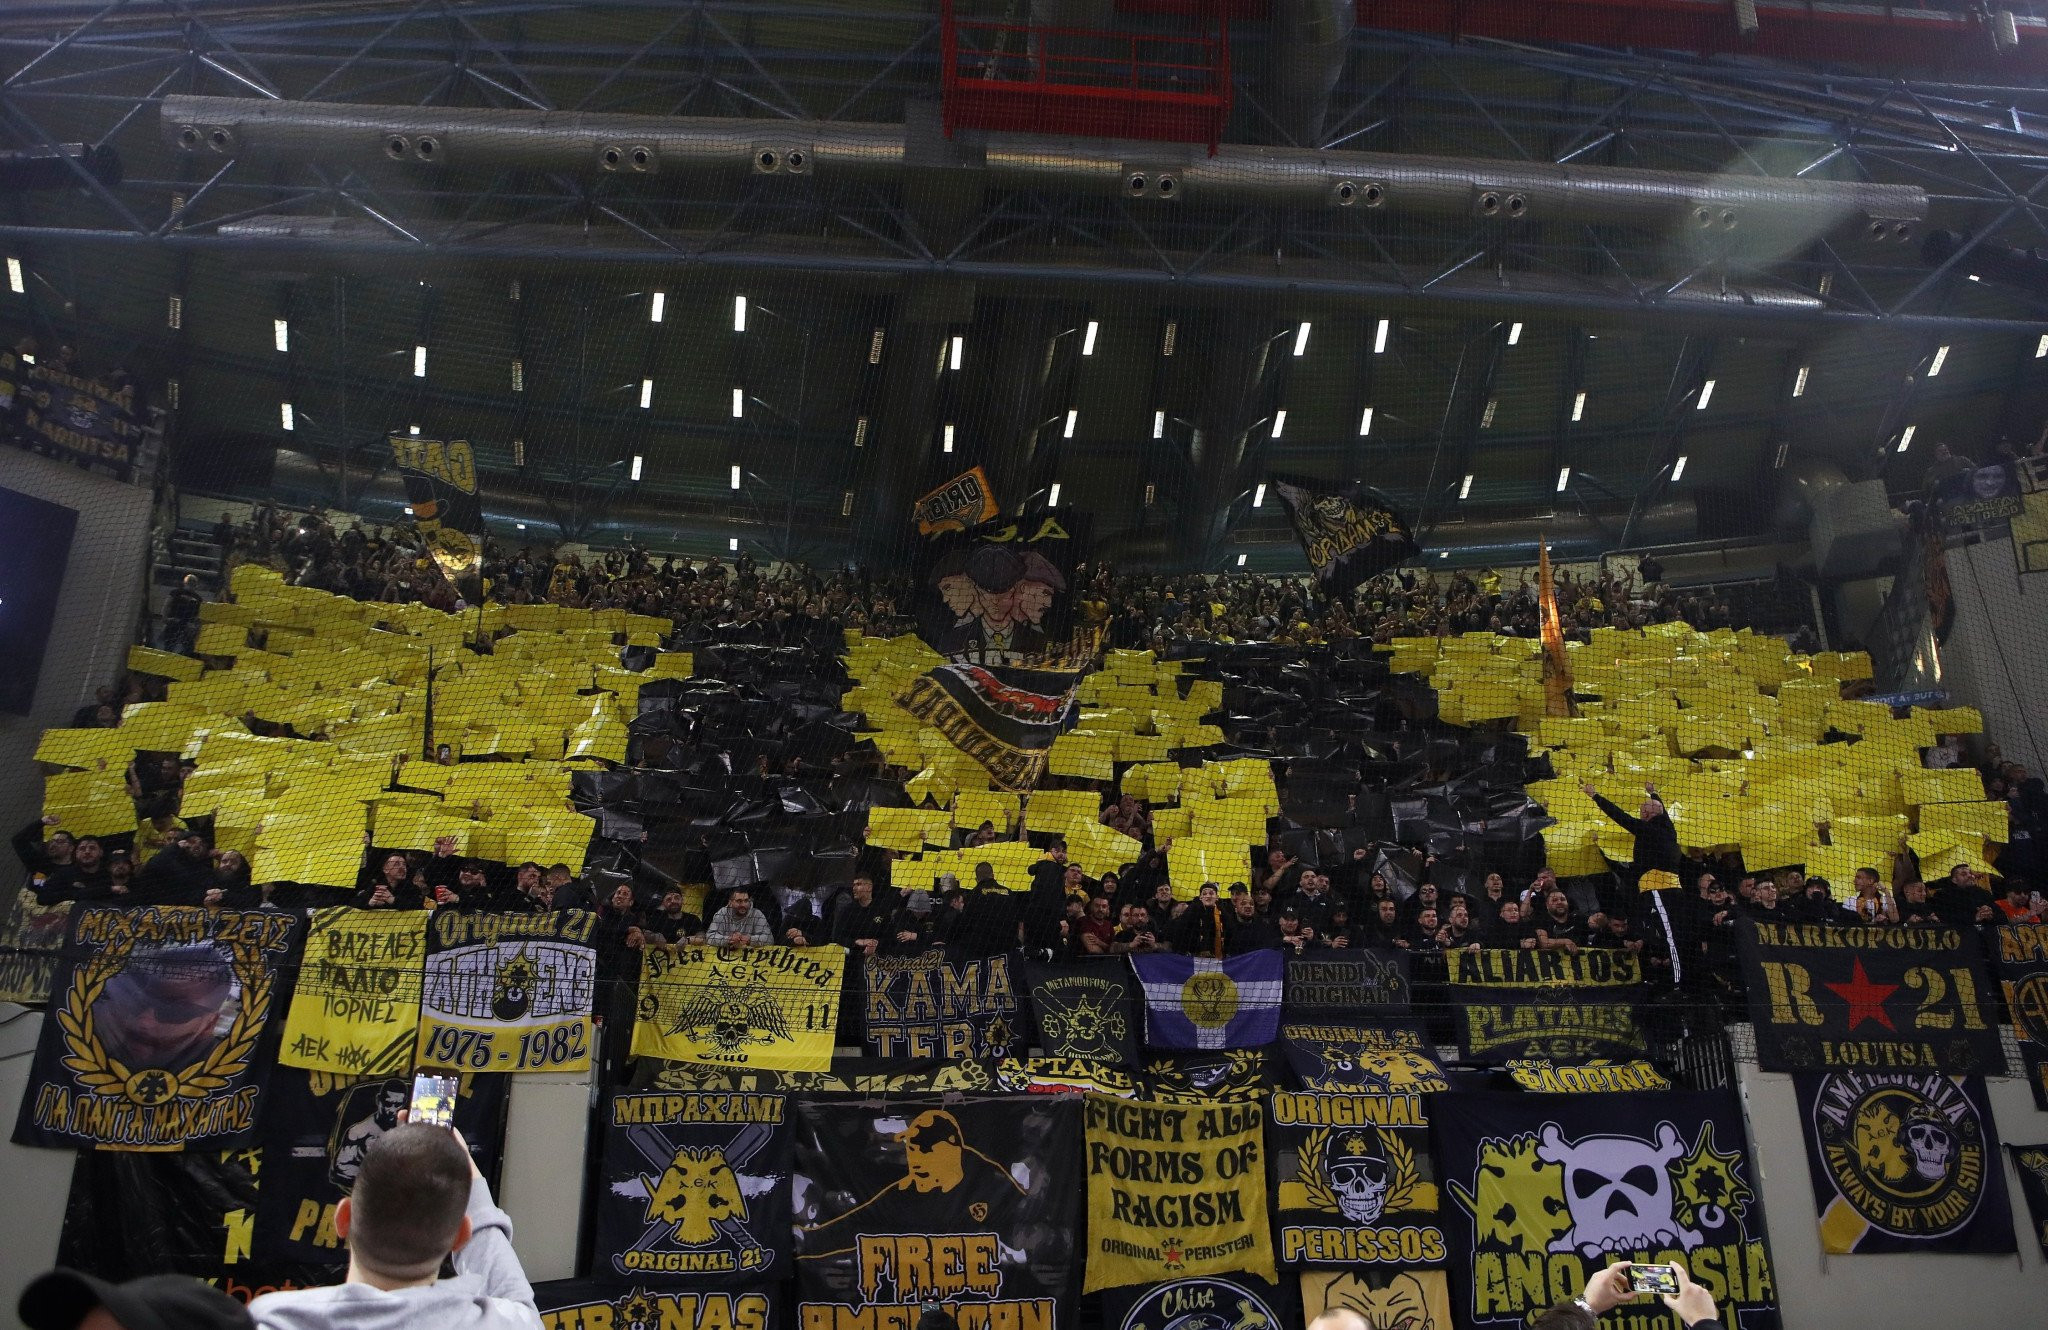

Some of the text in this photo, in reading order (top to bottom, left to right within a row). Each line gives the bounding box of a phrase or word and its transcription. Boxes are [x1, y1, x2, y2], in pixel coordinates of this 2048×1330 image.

[435, 908, 599, 947] Original 21
[1755, 922, 1961, 951] MARKOPOULO
[1288, 961, 1365, 984] MENIDI
[1458, 948, 1634, 983] ALIARTOS
[865, 954, 1017, 1022] KAMA
[1289, 984, 1389, 1007] ORIGINAL
[1761, 962, 1824, 1026] R
[1903, 966, 1988, 1030] 21
[640, 994, 659, 1021] 9
[424, 1025, 494, 1069] 1975
[517, 1023, 588, 1069] 1982
[1282, 1024, 1392, 1045] ORIGINAL
[1466, 1003, 1647, 1056] PLATAIES
[1820, 1041, 1938, 1067] LOUTSA
[1087, 1097, 1188, 1142] FIGHT
[1197, 1104, 1260, 1140] ALL
[1271, 1092, 1429, 1127] ORIGINAL
[1090, 1141, 1258, 1184] FORMS OF
[1826, 1142, 1981, 1230] ALWAYS BY YOUR SIDE
[1111, 1187, 1244, 1228] RACISM
[623, 1248, 763, 1272] ORIGINAL 21
[1101, 1234, 1255, 1261] ORIGINAL PERISTERI
[1282, 1226, 1447, 1264] PERISSOS
[856, 1233, 1002, 1303] FREE
[1475, 1251, 1585, 1315] ANO
